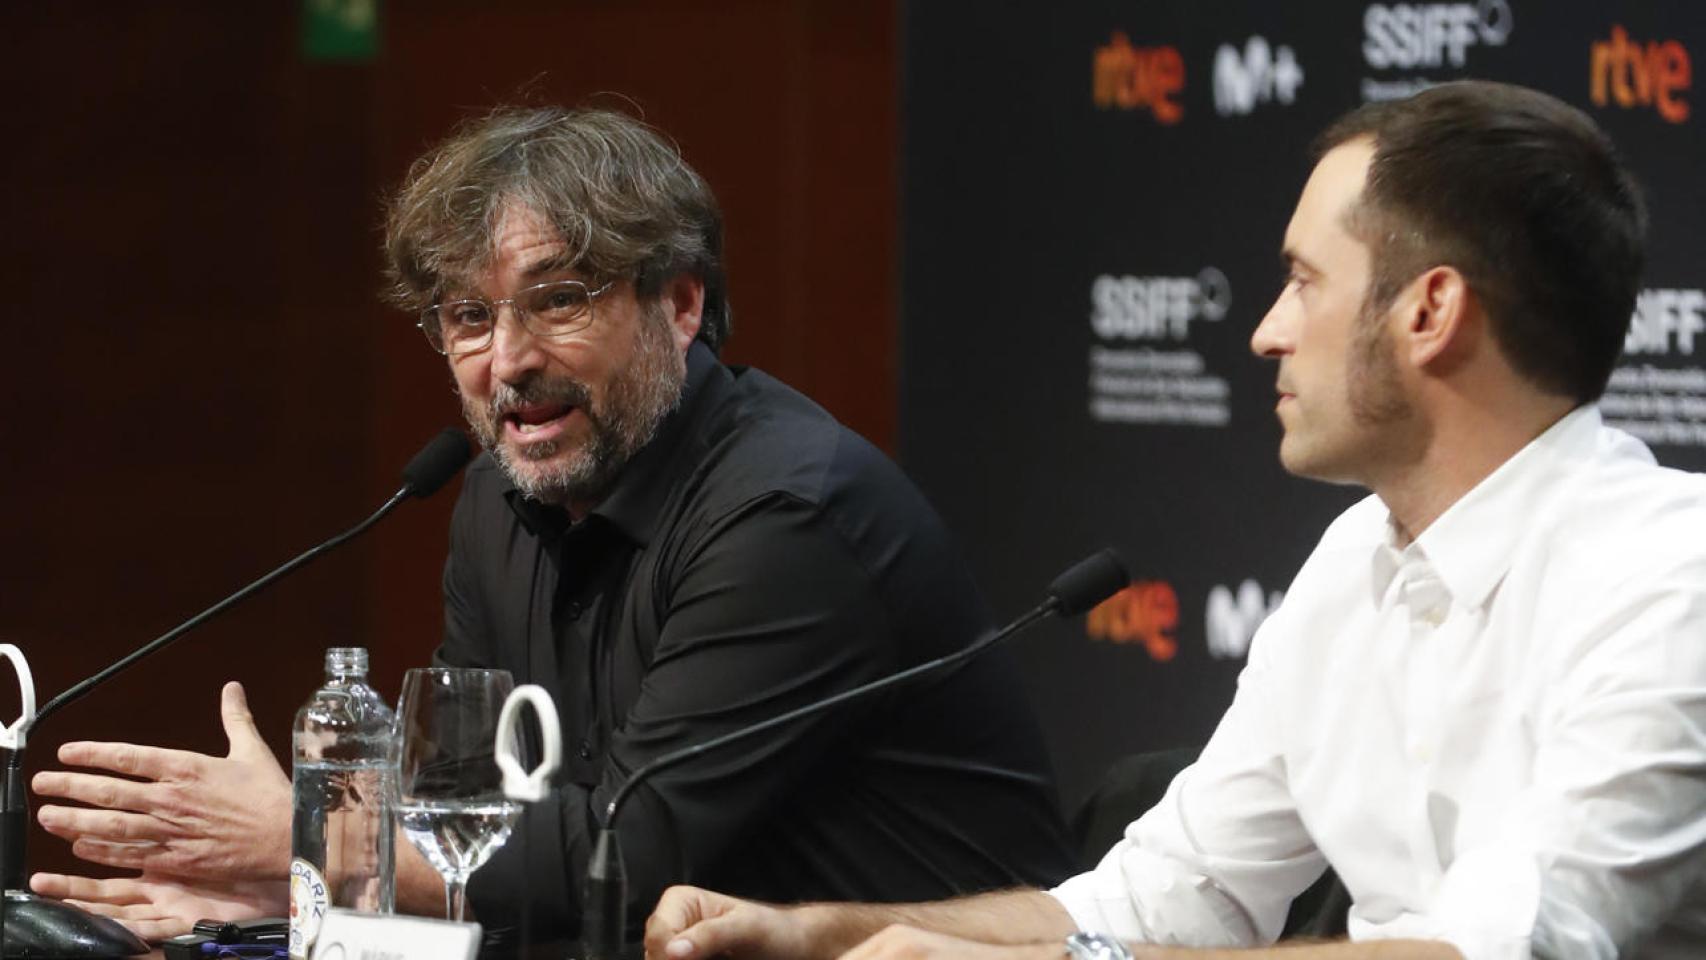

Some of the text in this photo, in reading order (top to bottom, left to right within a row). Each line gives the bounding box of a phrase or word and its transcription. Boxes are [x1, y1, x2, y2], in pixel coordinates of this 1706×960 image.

[1093, 31, 1186, 122] rtve
[1590, 24, 1692, 123] rtve
[1625, 288, 1706, 354] SIFF
